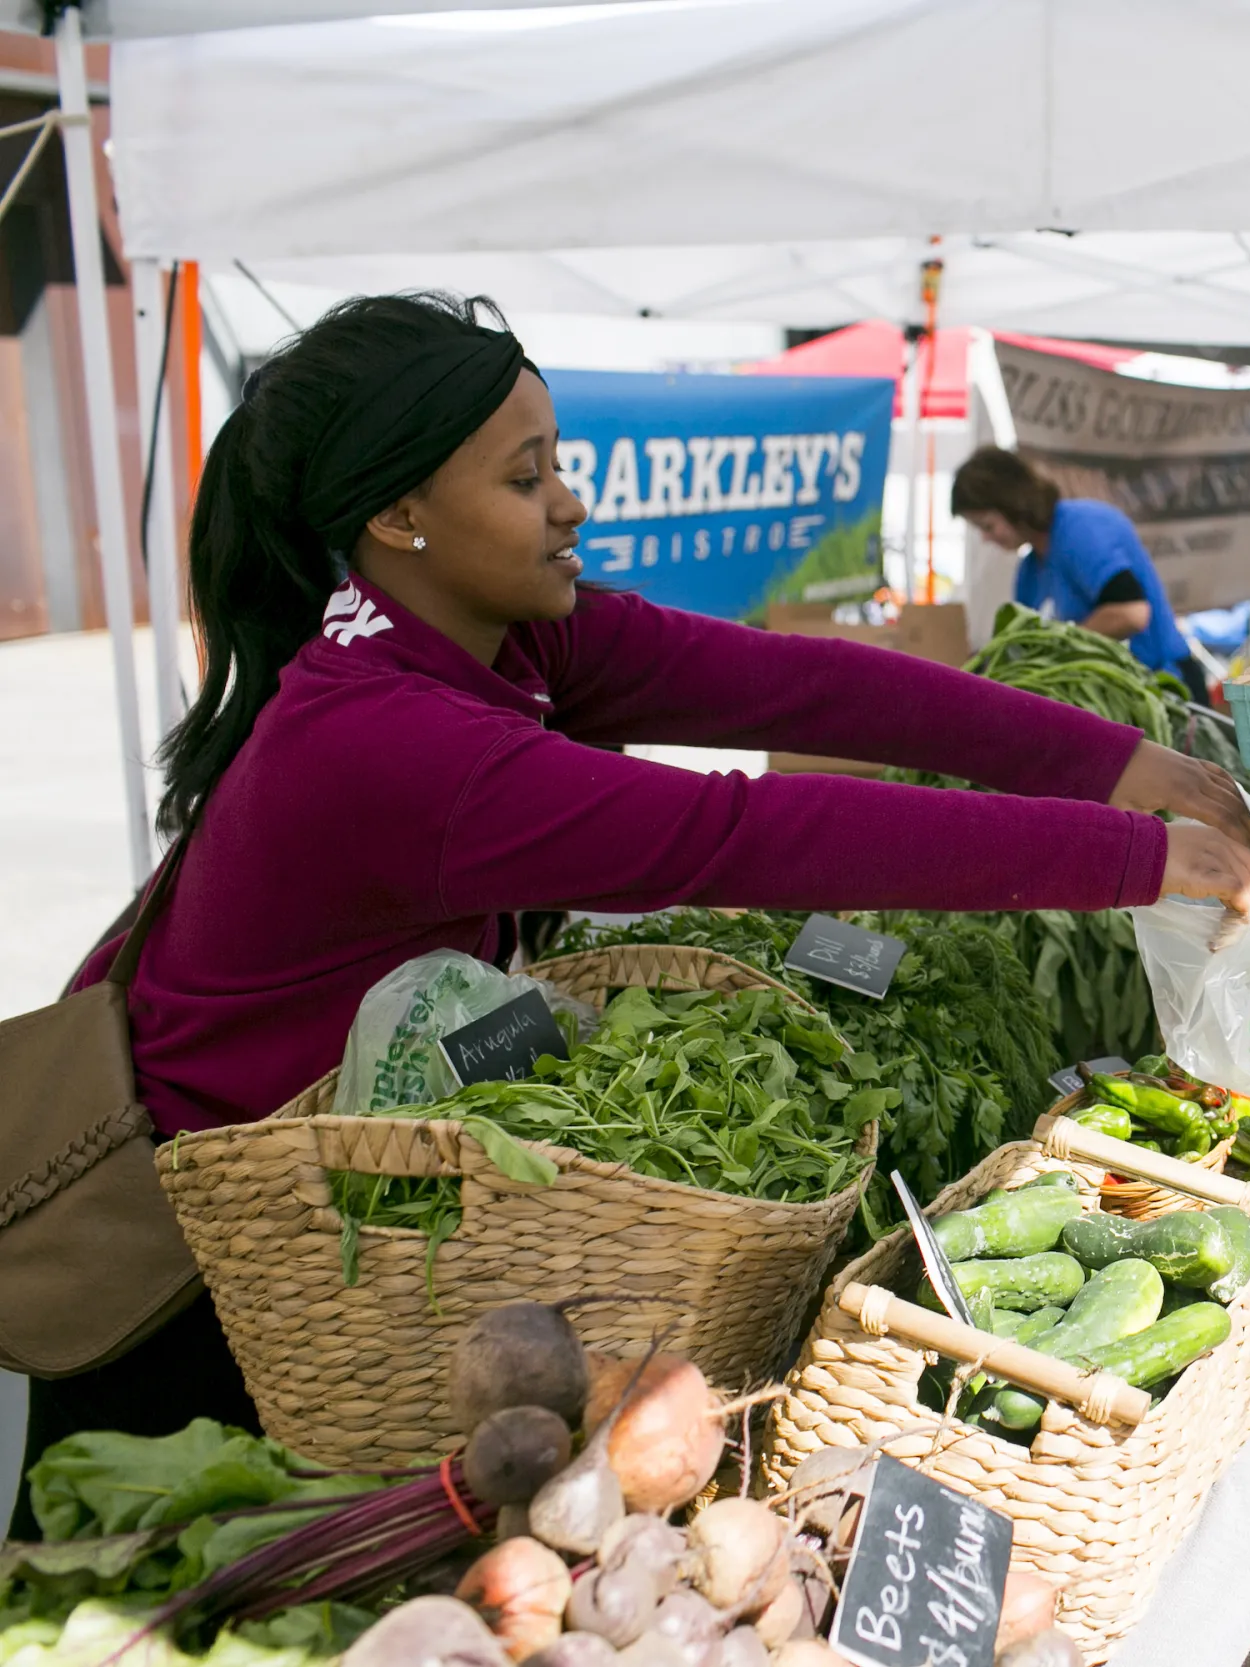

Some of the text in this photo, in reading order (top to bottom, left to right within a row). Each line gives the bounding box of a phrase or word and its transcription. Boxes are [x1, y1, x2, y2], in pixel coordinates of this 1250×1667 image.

[557, 431, 866, 523] BARKLEY'S
[641, 518, 786, 568] BISTRO
[807, 935, 845, 964] Dill
[458, 1010, 537, 1072] Arugula
[855, 1503, 925, 1650] Beets
